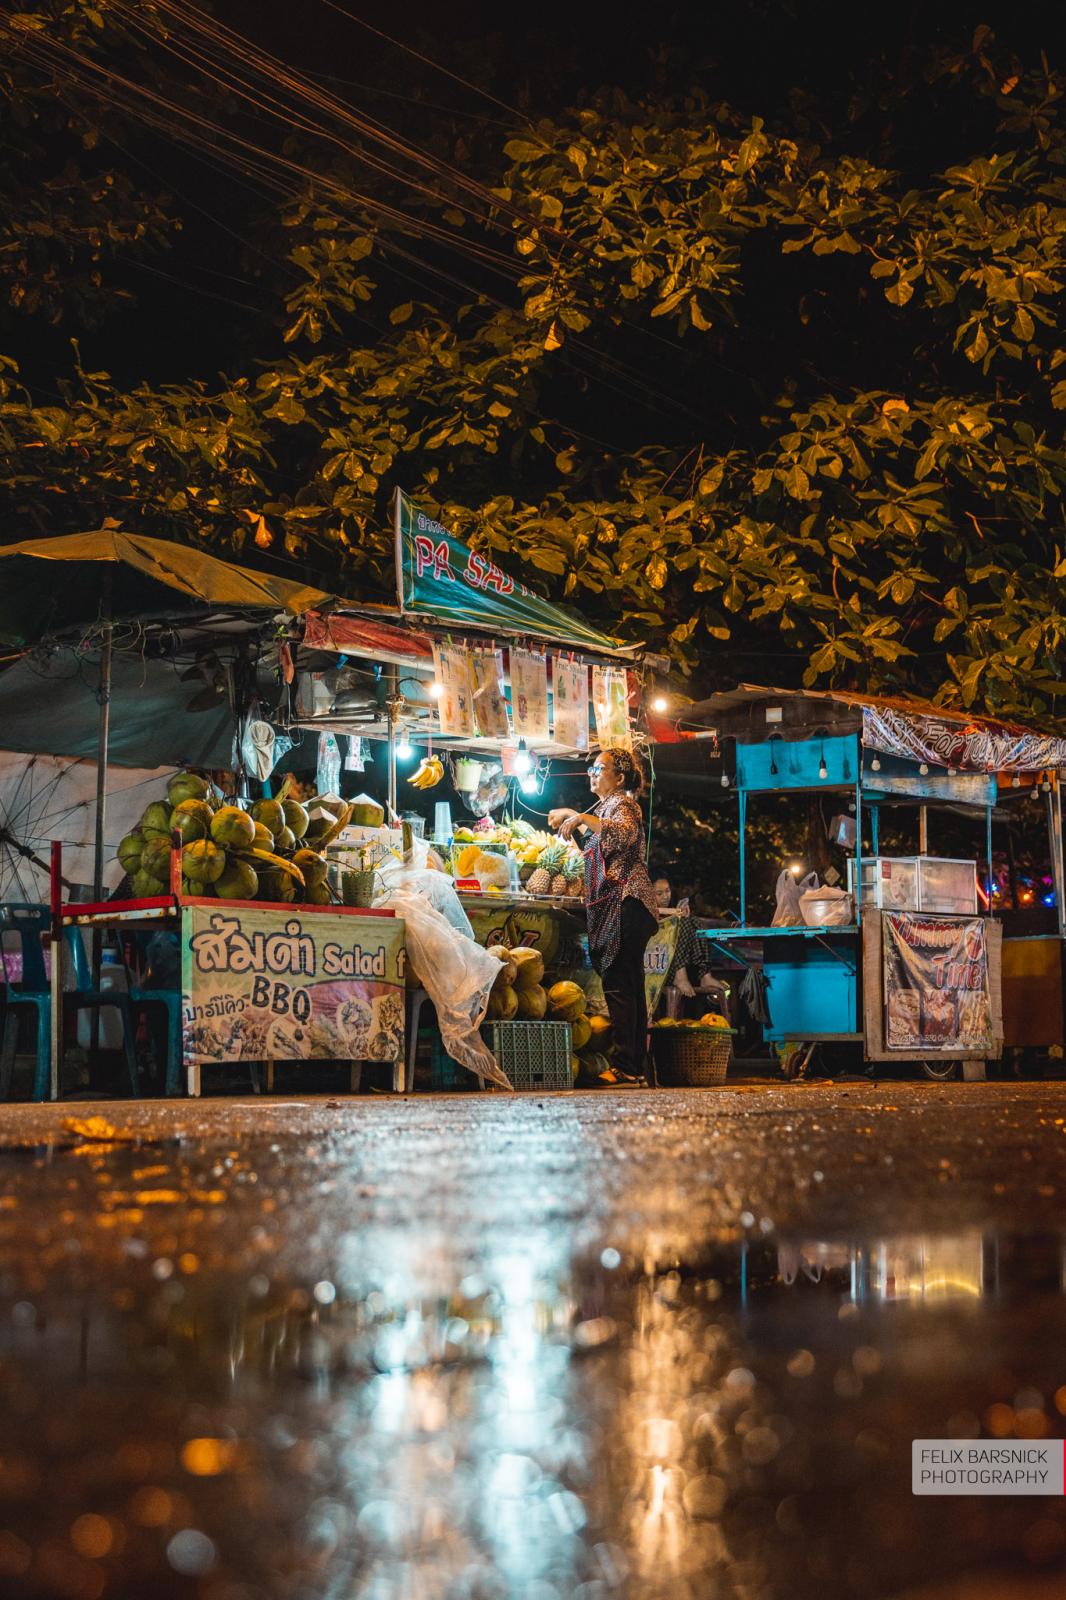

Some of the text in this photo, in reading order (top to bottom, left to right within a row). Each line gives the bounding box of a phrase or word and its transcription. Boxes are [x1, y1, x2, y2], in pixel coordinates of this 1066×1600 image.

[414, 535, 455, 582] PA
[920, 721, 963, 760] For
[189, 913, 316, 977] ส้มตำ
[891, 913, 965, 958] Yummy
[323, 942, 386, 977] Salad
[931, 954, 982, 988] Time
[252, 974, 310, 1025] BBQ
